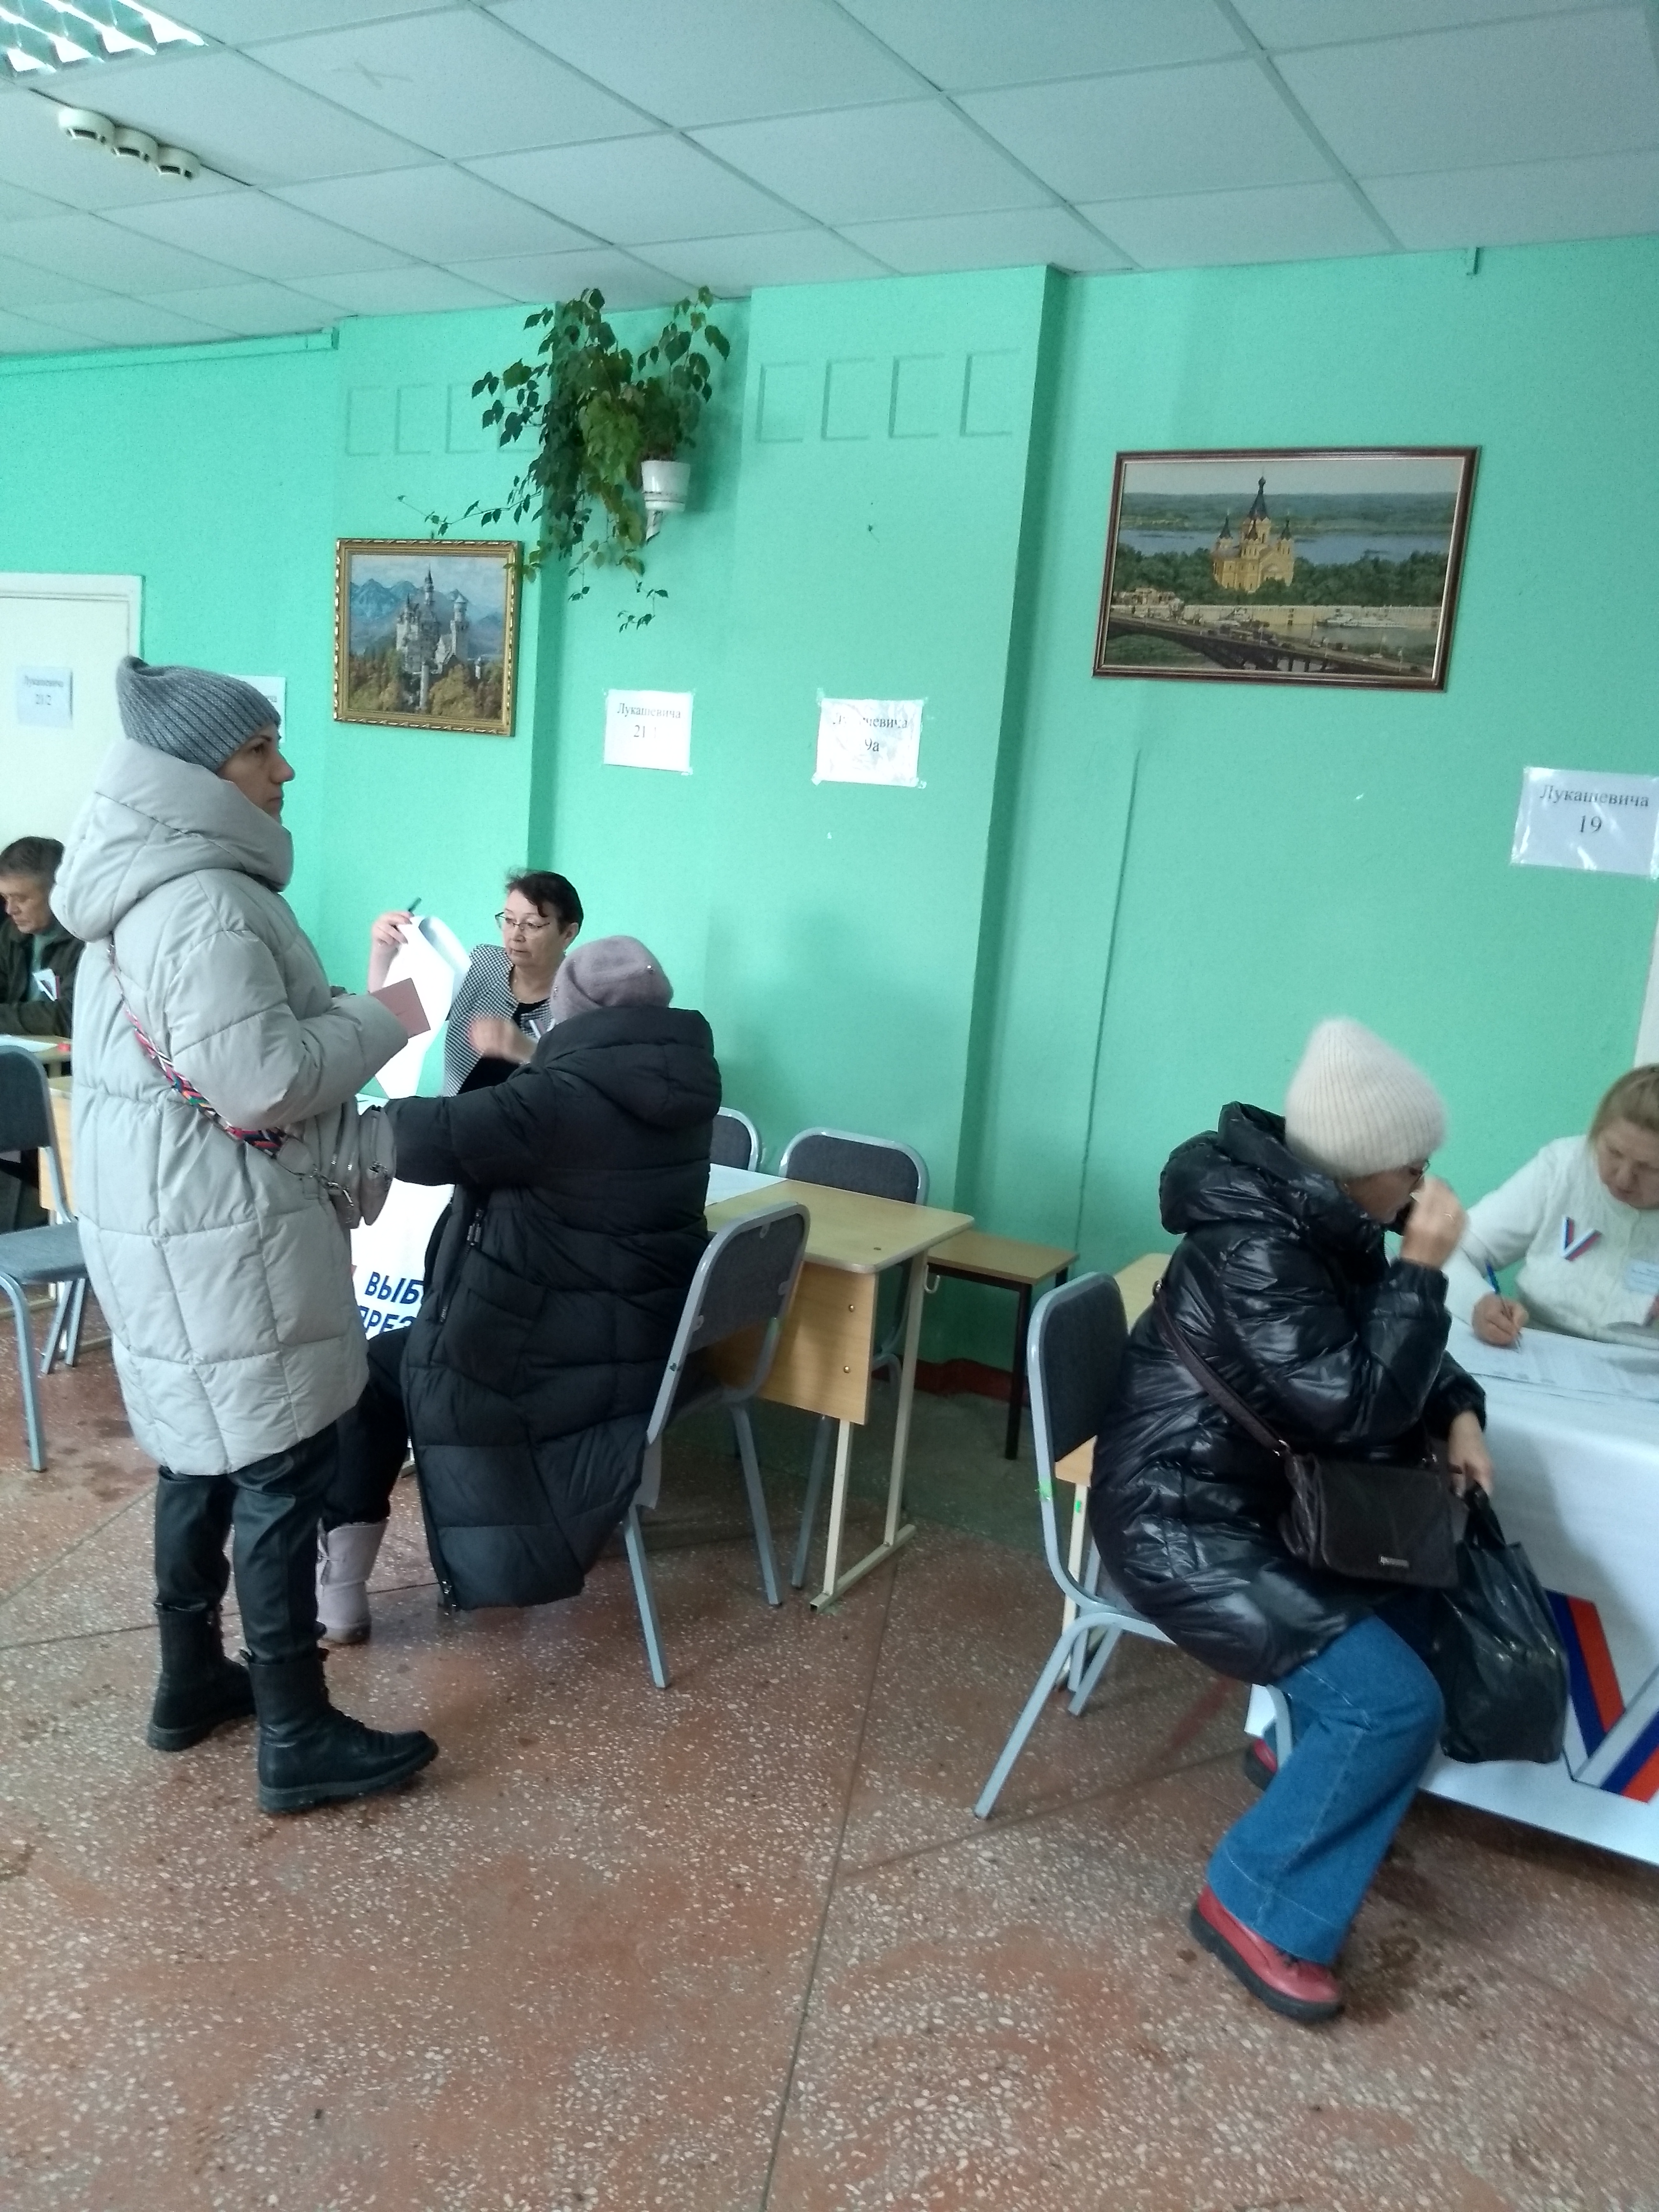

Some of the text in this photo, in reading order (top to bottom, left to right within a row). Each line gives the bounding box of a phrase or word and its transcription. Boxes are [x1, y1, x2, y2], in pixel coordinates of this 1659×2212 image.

[616, 702, 681, 719] Лукашевича
[1540, 785, 1649, 807] Лукашевича
[1579, 815, 1603, 833] 19
